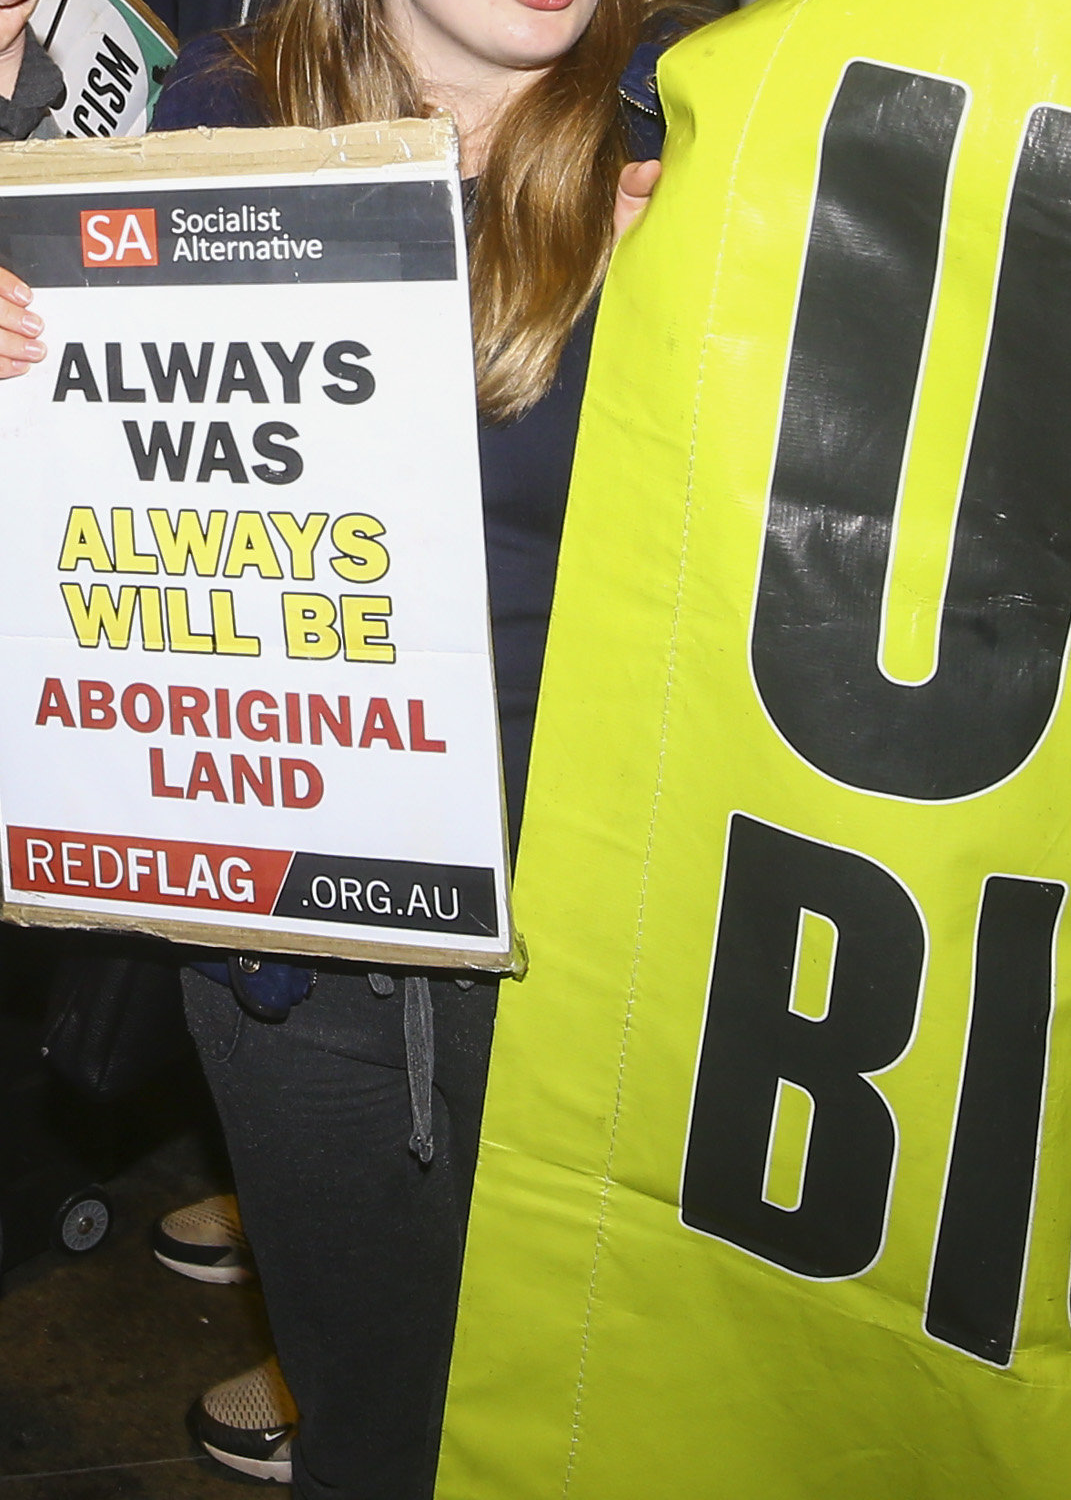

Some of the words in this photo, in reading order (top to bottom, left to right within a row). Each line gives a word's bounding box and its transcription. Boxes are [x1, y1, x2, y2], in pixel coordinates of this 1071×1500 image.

[86, 214, 152, 261] SA
[171, 205, 281, 234] Socialist
[173, 234, 323, 262] Alternative
[52, 340, 377, 406] ALWAYS
[122, 419, 305, 485] WAS
[58, 505, 390, 583] ALWAYS
[60, 582, 261, 657] WILL
[282, 592, 397, 664] BE
[34, 677, 447, 754] ABORIGINAL
[149, 747, 325, 810] LAND
[25, 838, 256, 904] REDFLAG
[301, 873, 460, 921] .ORG.AU
